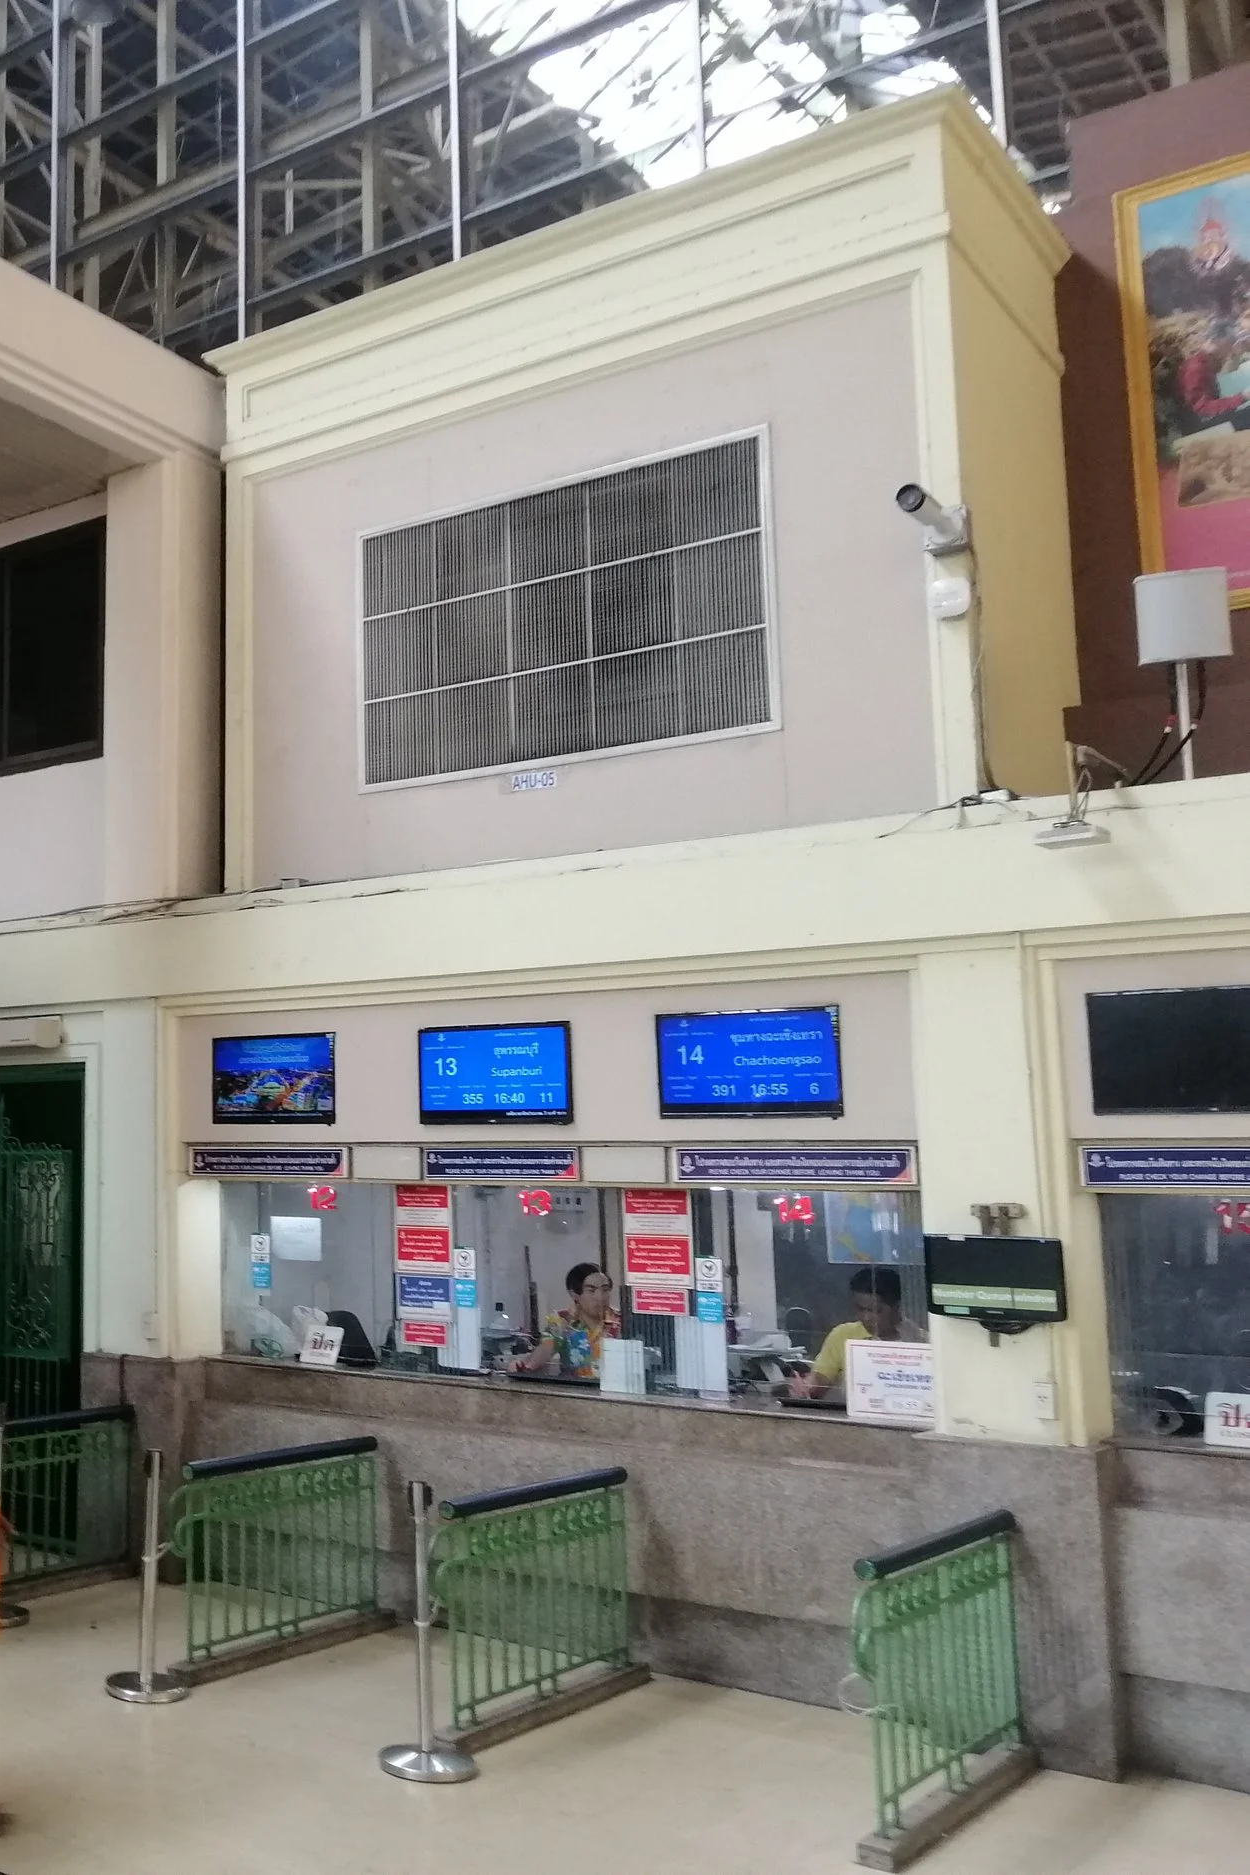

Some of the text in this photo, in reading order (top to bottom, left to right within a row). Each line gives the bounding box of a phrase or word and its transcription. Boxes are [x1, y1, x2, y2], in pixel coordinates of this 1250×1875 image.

[513, 772, 554, 789] AHU-05
[677, 1044, 704, 1065] 14
[733, 1055, 822, 1067] Chachoengsao
[434, 1057, 458, 1076] 13
[491, 1066, 543, 1078] Supanburi
[462, 1092, 553, 1105] 355 16:40 11
[712, 1083, 820, 1096] 391 16:55 6
[307, 1185, 337, 1210] 12
[517, 1190, 552, 1216] 13
[774, 1195, 814, 1225] 14
